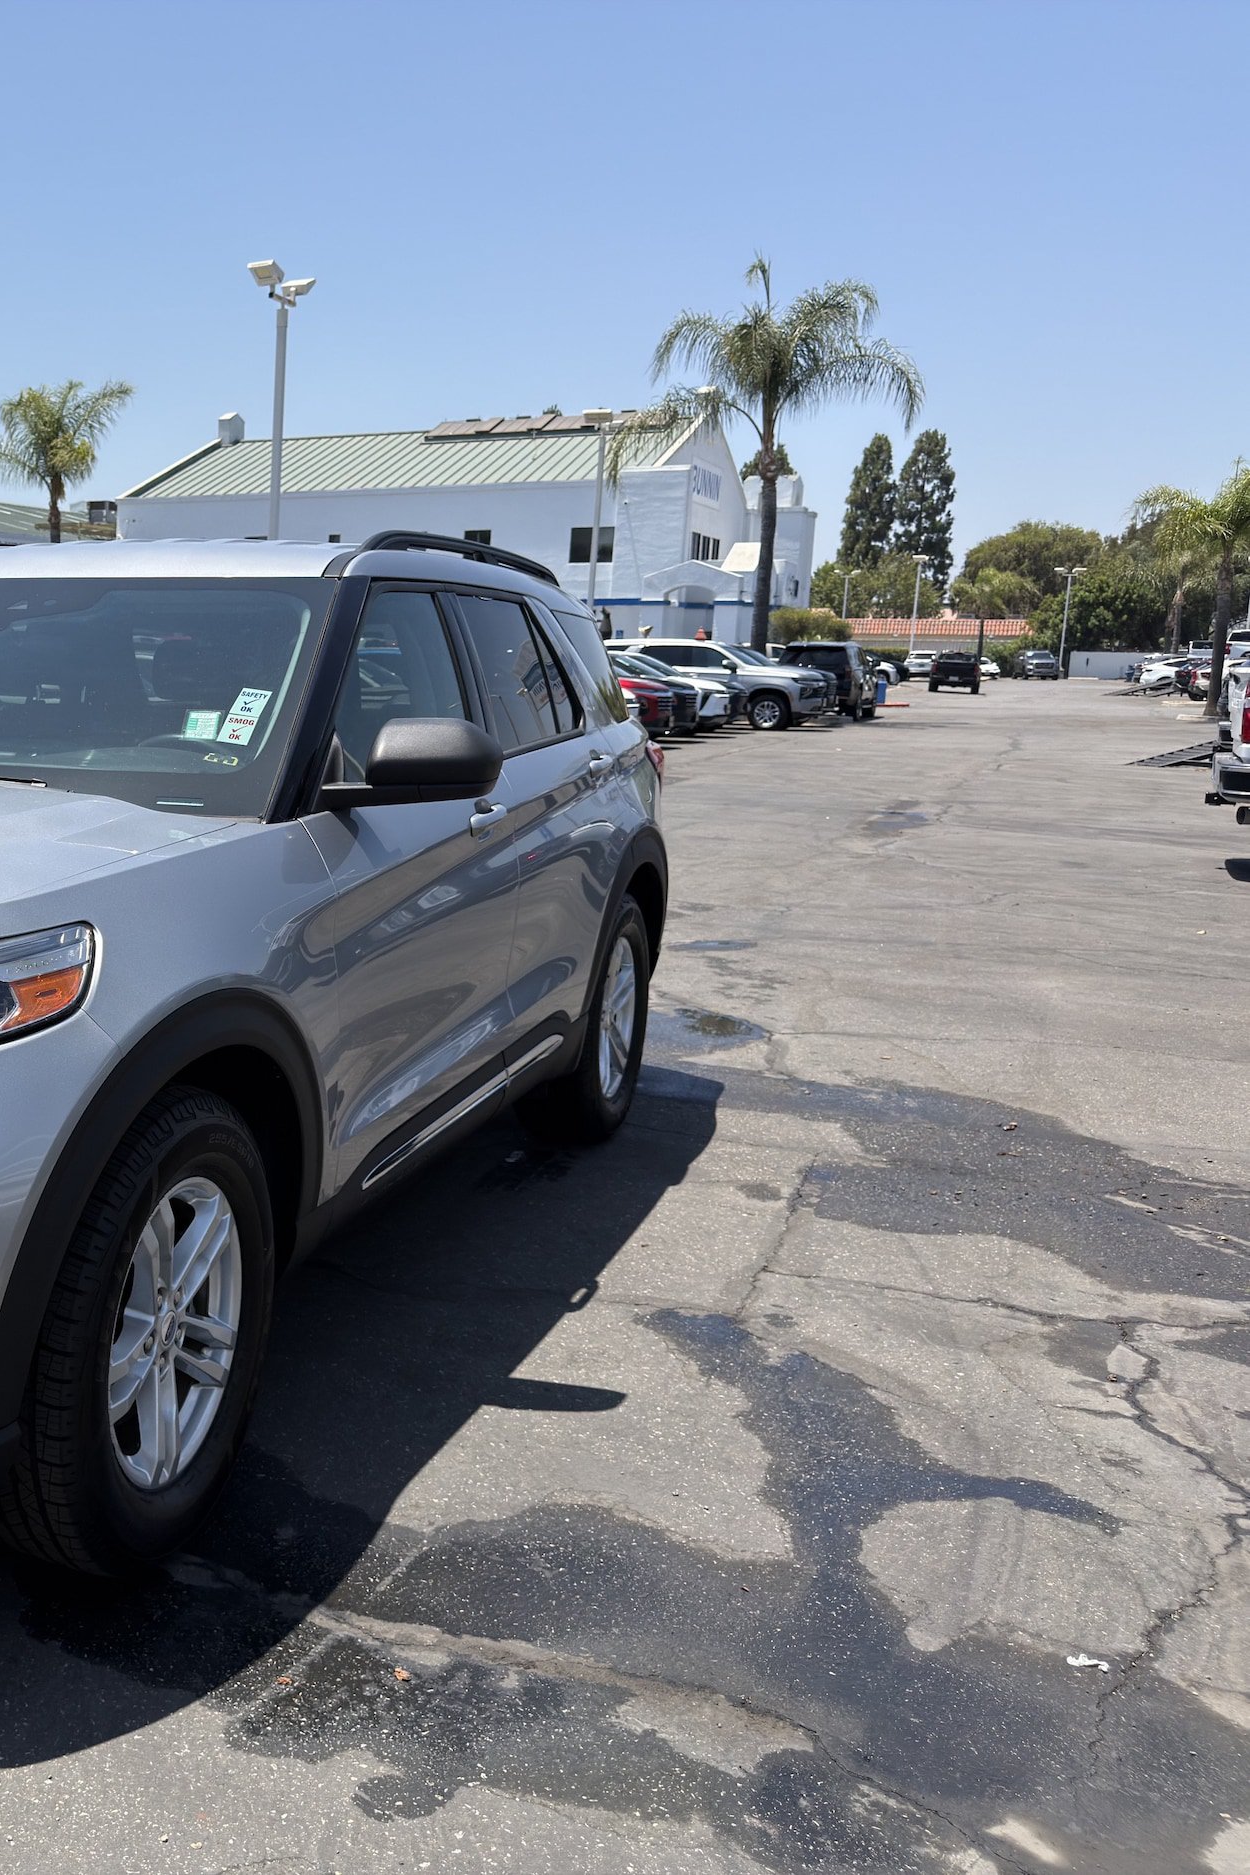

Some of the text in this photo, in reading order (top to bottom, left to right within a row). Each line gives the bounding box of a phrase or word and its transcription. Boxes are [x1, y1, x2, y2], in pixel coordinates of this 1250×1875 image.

[241, 690, 268, 699] SAFETY
[240, 705, 254, 713] OK
[228, 716, 255, 726] SMOG
[228, 733, 242, 741] OK
